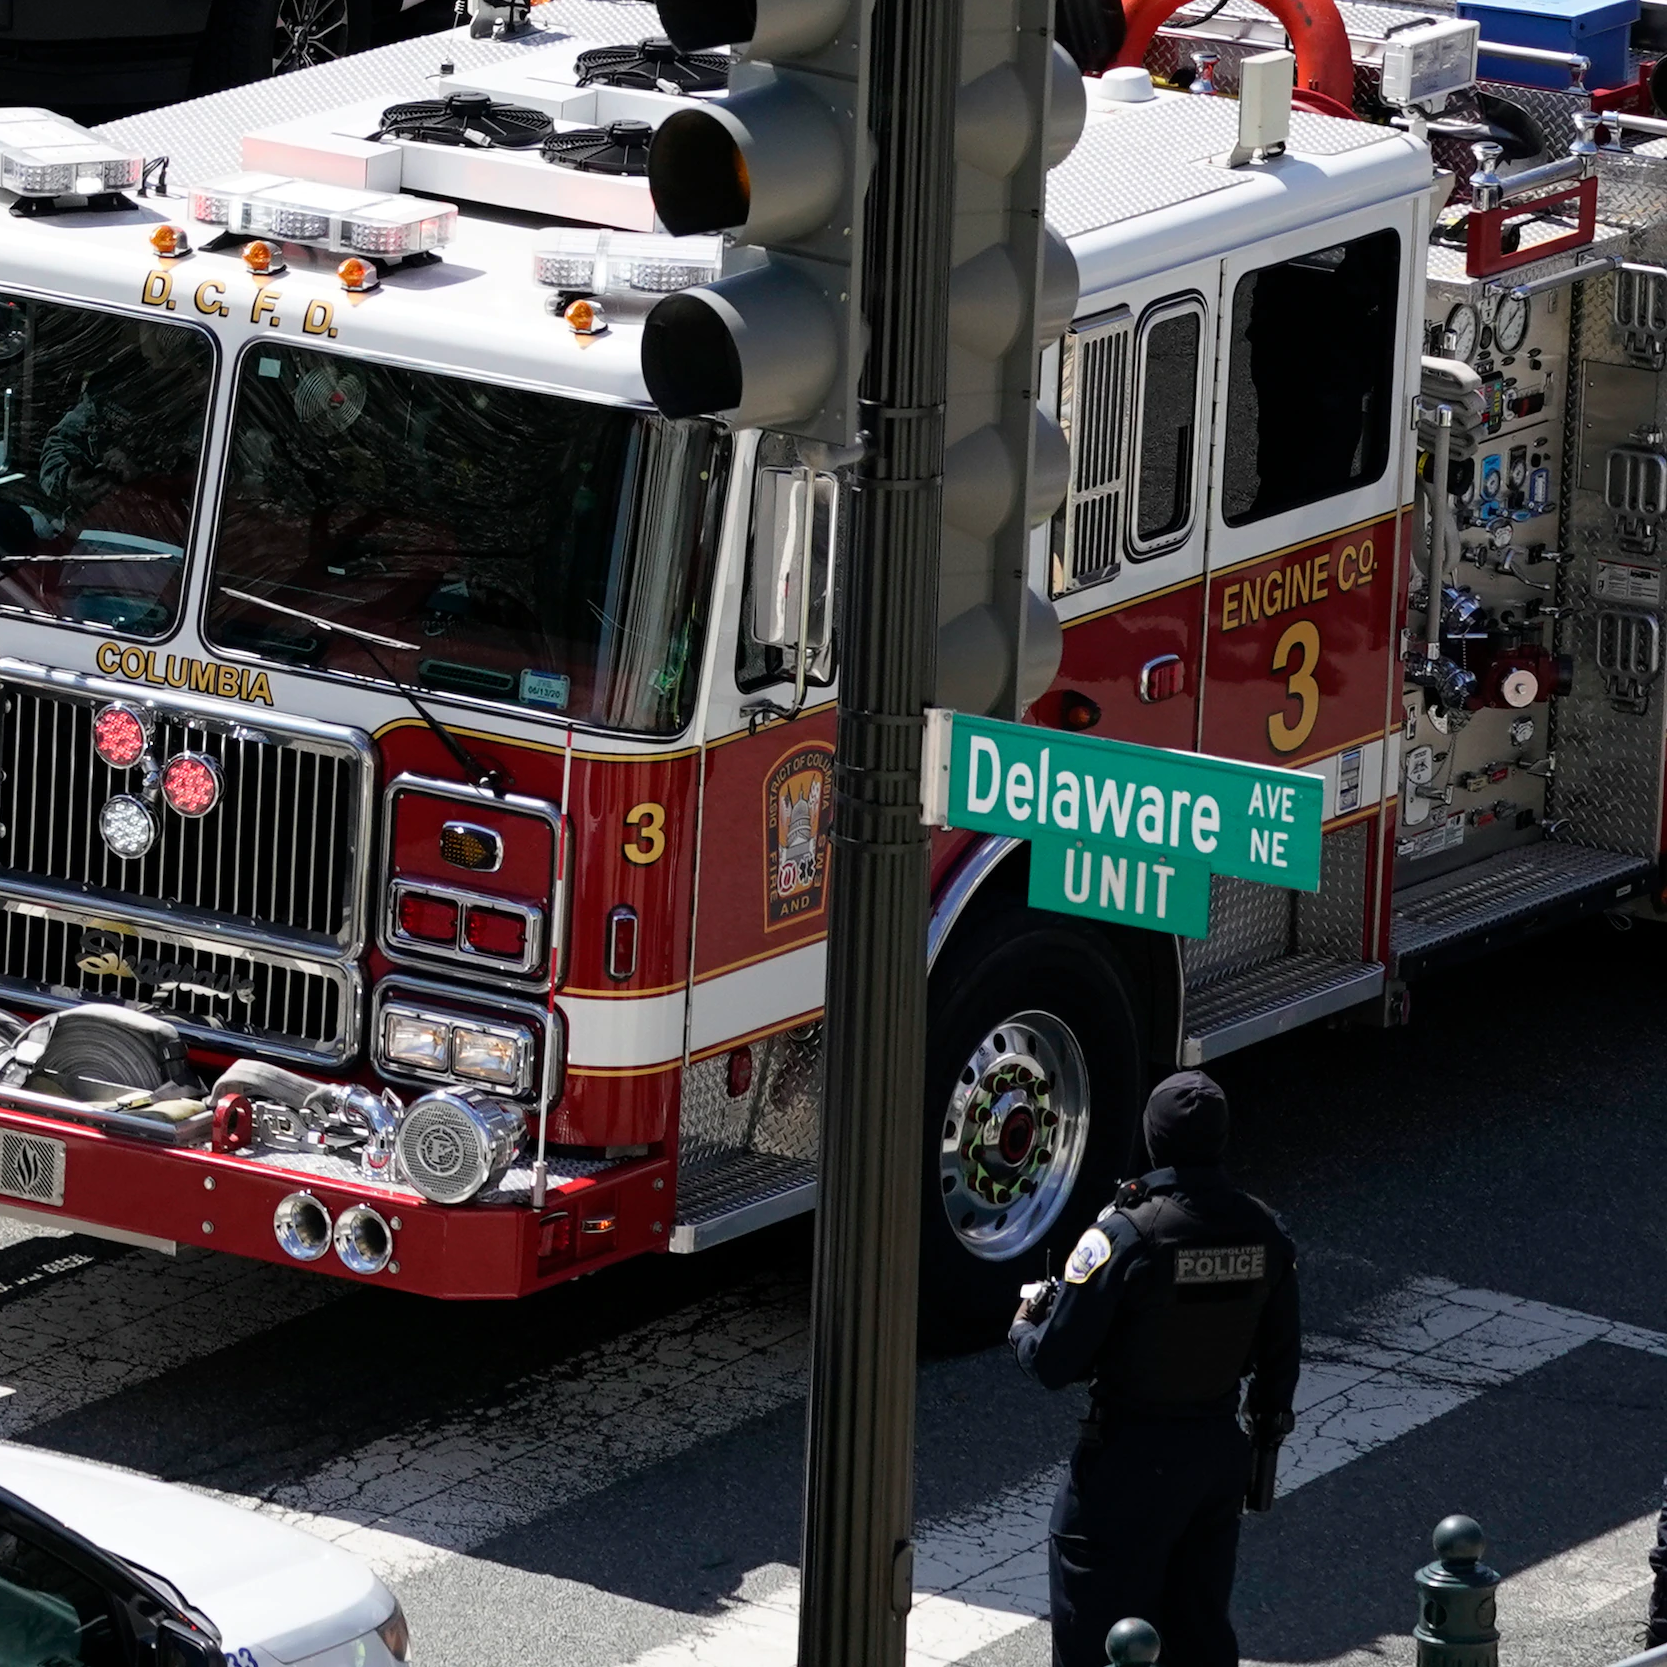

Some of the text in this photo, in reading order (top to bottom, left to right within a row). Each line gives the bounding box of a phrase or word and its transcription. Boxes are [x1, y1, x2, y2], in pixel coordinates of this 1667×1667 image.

[142, 270, 338, 338] D. C. F. D.
[1222, 553, 1331, 632] ENGINE
[97, 642, 273, 706] COLUMBIA
[1268, 620, 1320, 753] 3
[769, 753, 834, 829] DISTRICT OF COLUMBIA
[967, 735, 1295, 854] Delaware AVE
[623, 802, 666, 865] 3
[1249, 828, 1289, 868] NE
[769, 855, 778, 903] FIRE
[780, 895, 811, 916] AND
[1064, 848, 1175, 919] UNIT
[1178, 1254, 1264, 1276] POLICE
